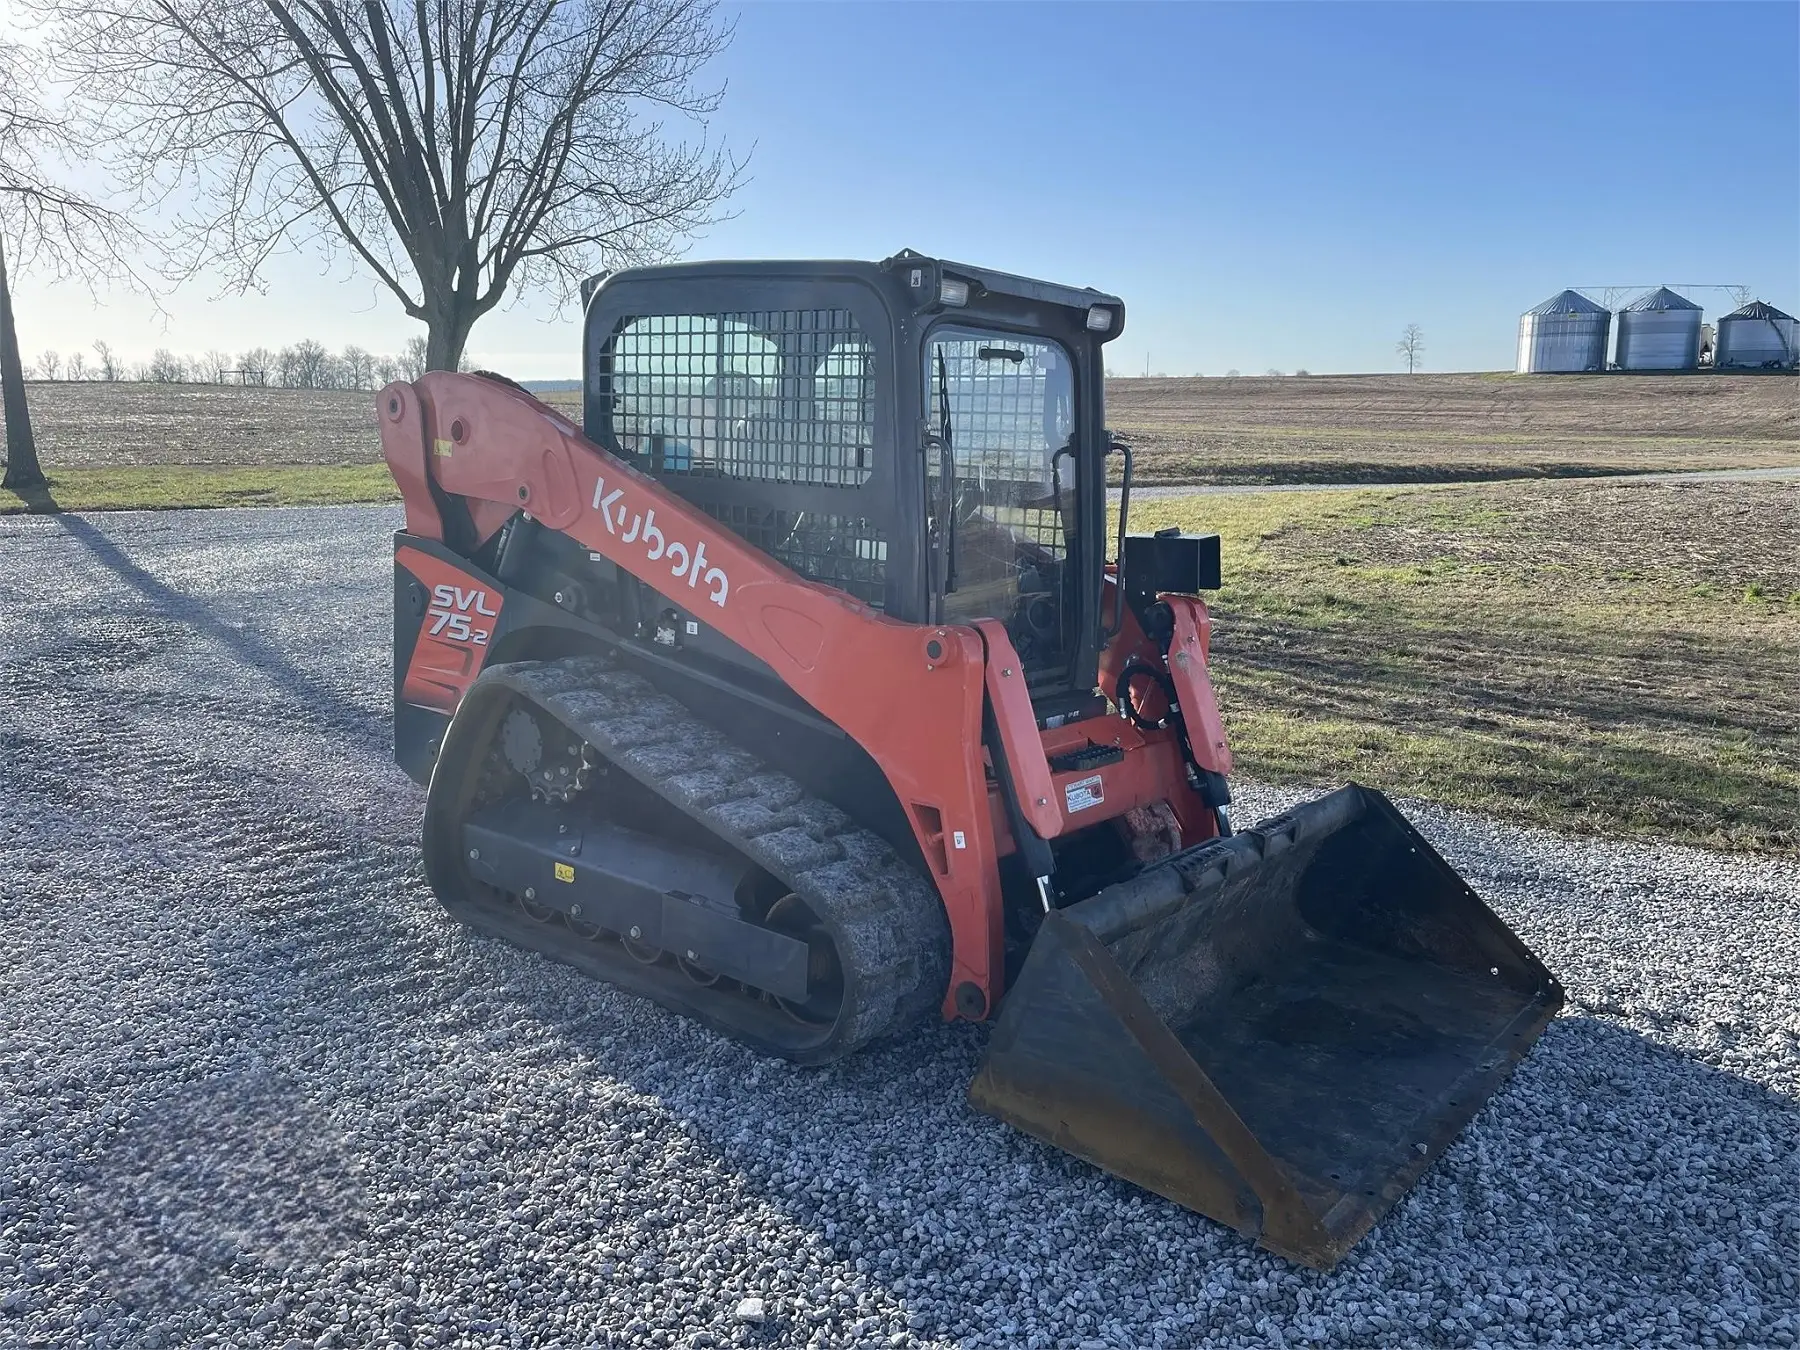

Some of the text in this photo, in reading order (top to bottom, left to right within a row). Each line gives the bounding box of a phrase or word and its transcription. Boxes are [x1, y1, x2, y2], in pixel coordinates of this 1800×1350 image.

[592, 476, 729, 608] Kubota
[431, 584, 497, 617] SVL
[428, 608, 489, 646] 75-2
